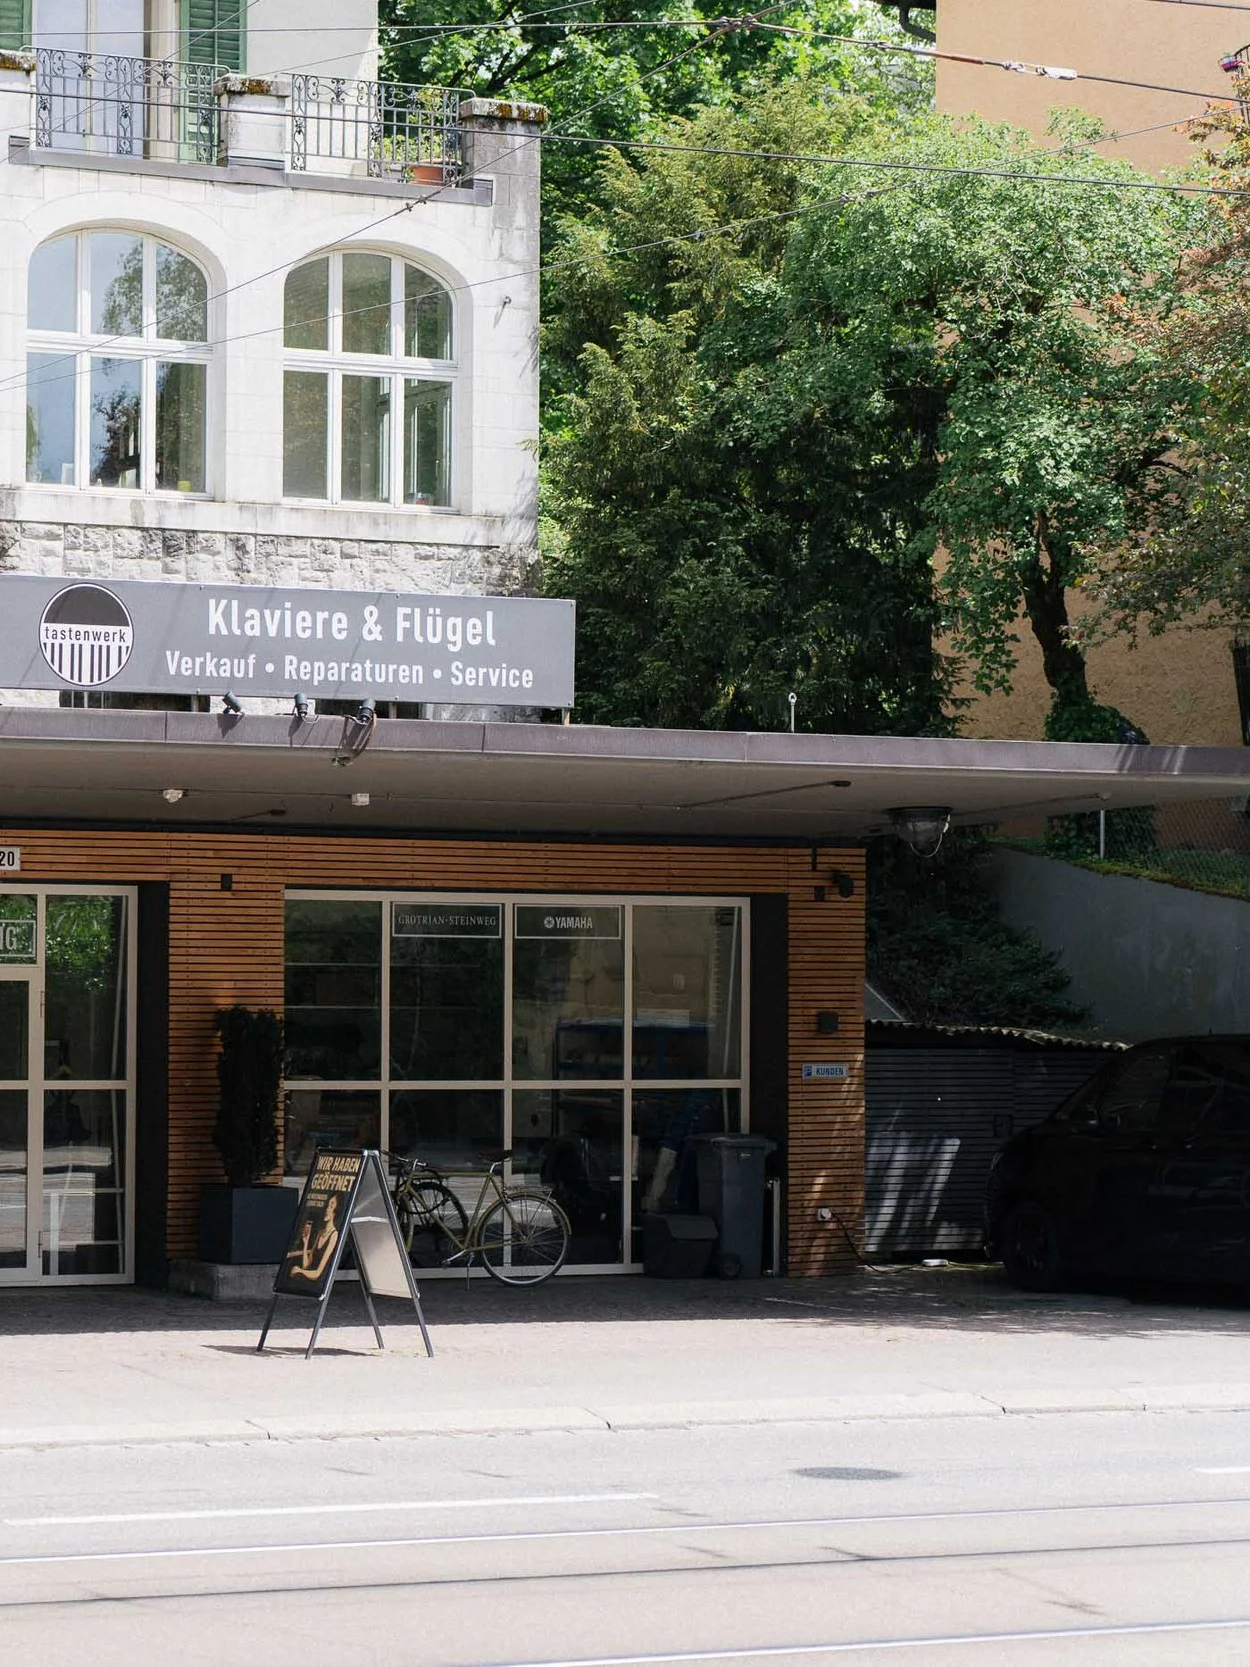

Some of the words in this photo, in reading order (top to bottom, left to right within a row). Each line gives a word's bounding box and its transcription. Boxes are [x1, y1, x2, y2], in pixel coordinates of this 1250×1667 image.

[45, 626, 126, 642] tastenwerk
[208, 599, 348, 640] Klaviere
[362, 605, 383, 641] &
[396, 606, 496, 652] Flügel
[166, 650, 256, 678] Verkauf
[284, 655, 423, 685] Reparaturen
[451, 661, 533, 688] Service
[555, 916, 593, 929] YAMAHA
[816, 1067, 844, 1076] KUNDEN
[317, 1156, 334, 1171] WIR
[332, 1157, 361, 1173] HABEN
[311, 1172, 356, 1192] GEÖFFNET
